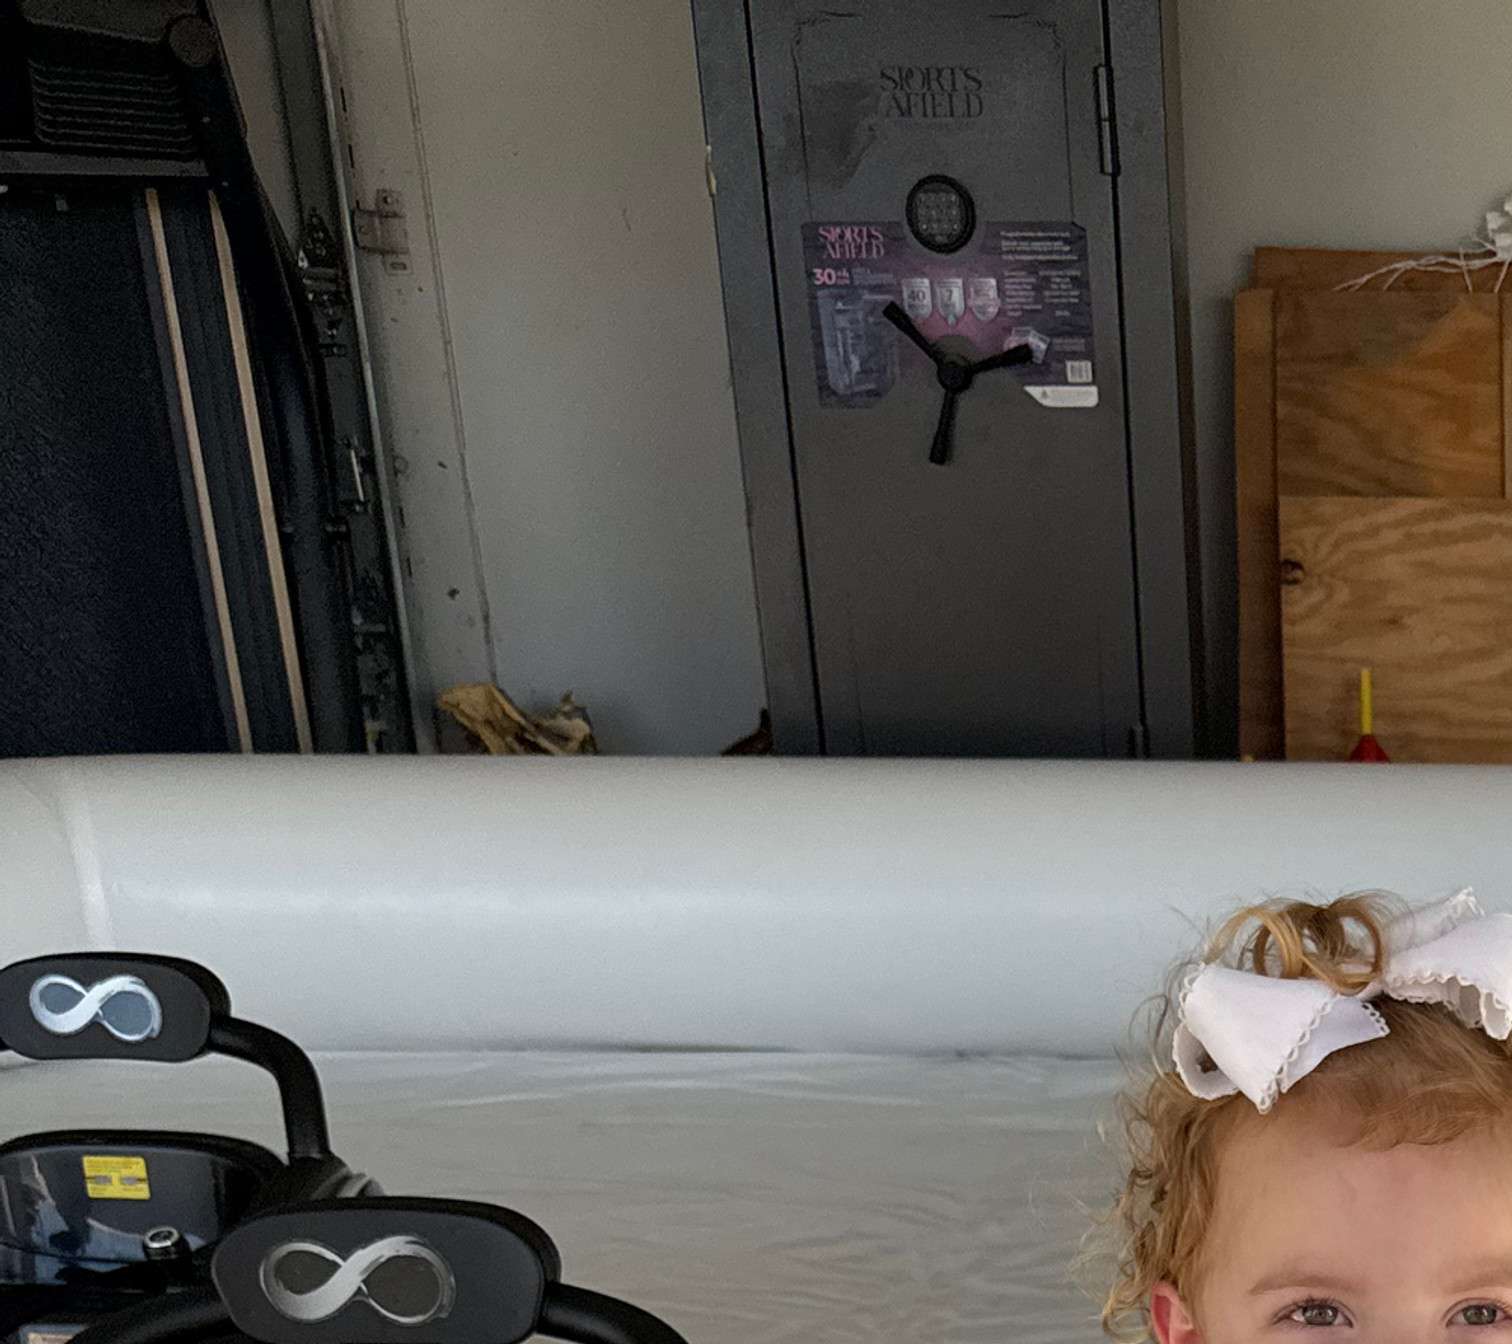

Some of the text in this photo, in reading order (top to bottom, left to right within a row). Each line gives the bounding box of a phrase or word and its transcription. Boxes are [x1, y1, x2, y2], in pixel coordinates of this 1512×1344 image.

[886, 92, 983, 118] AFIELD
[812, 268, 836, 285] 30
[909, 289, 926, 301] 40
